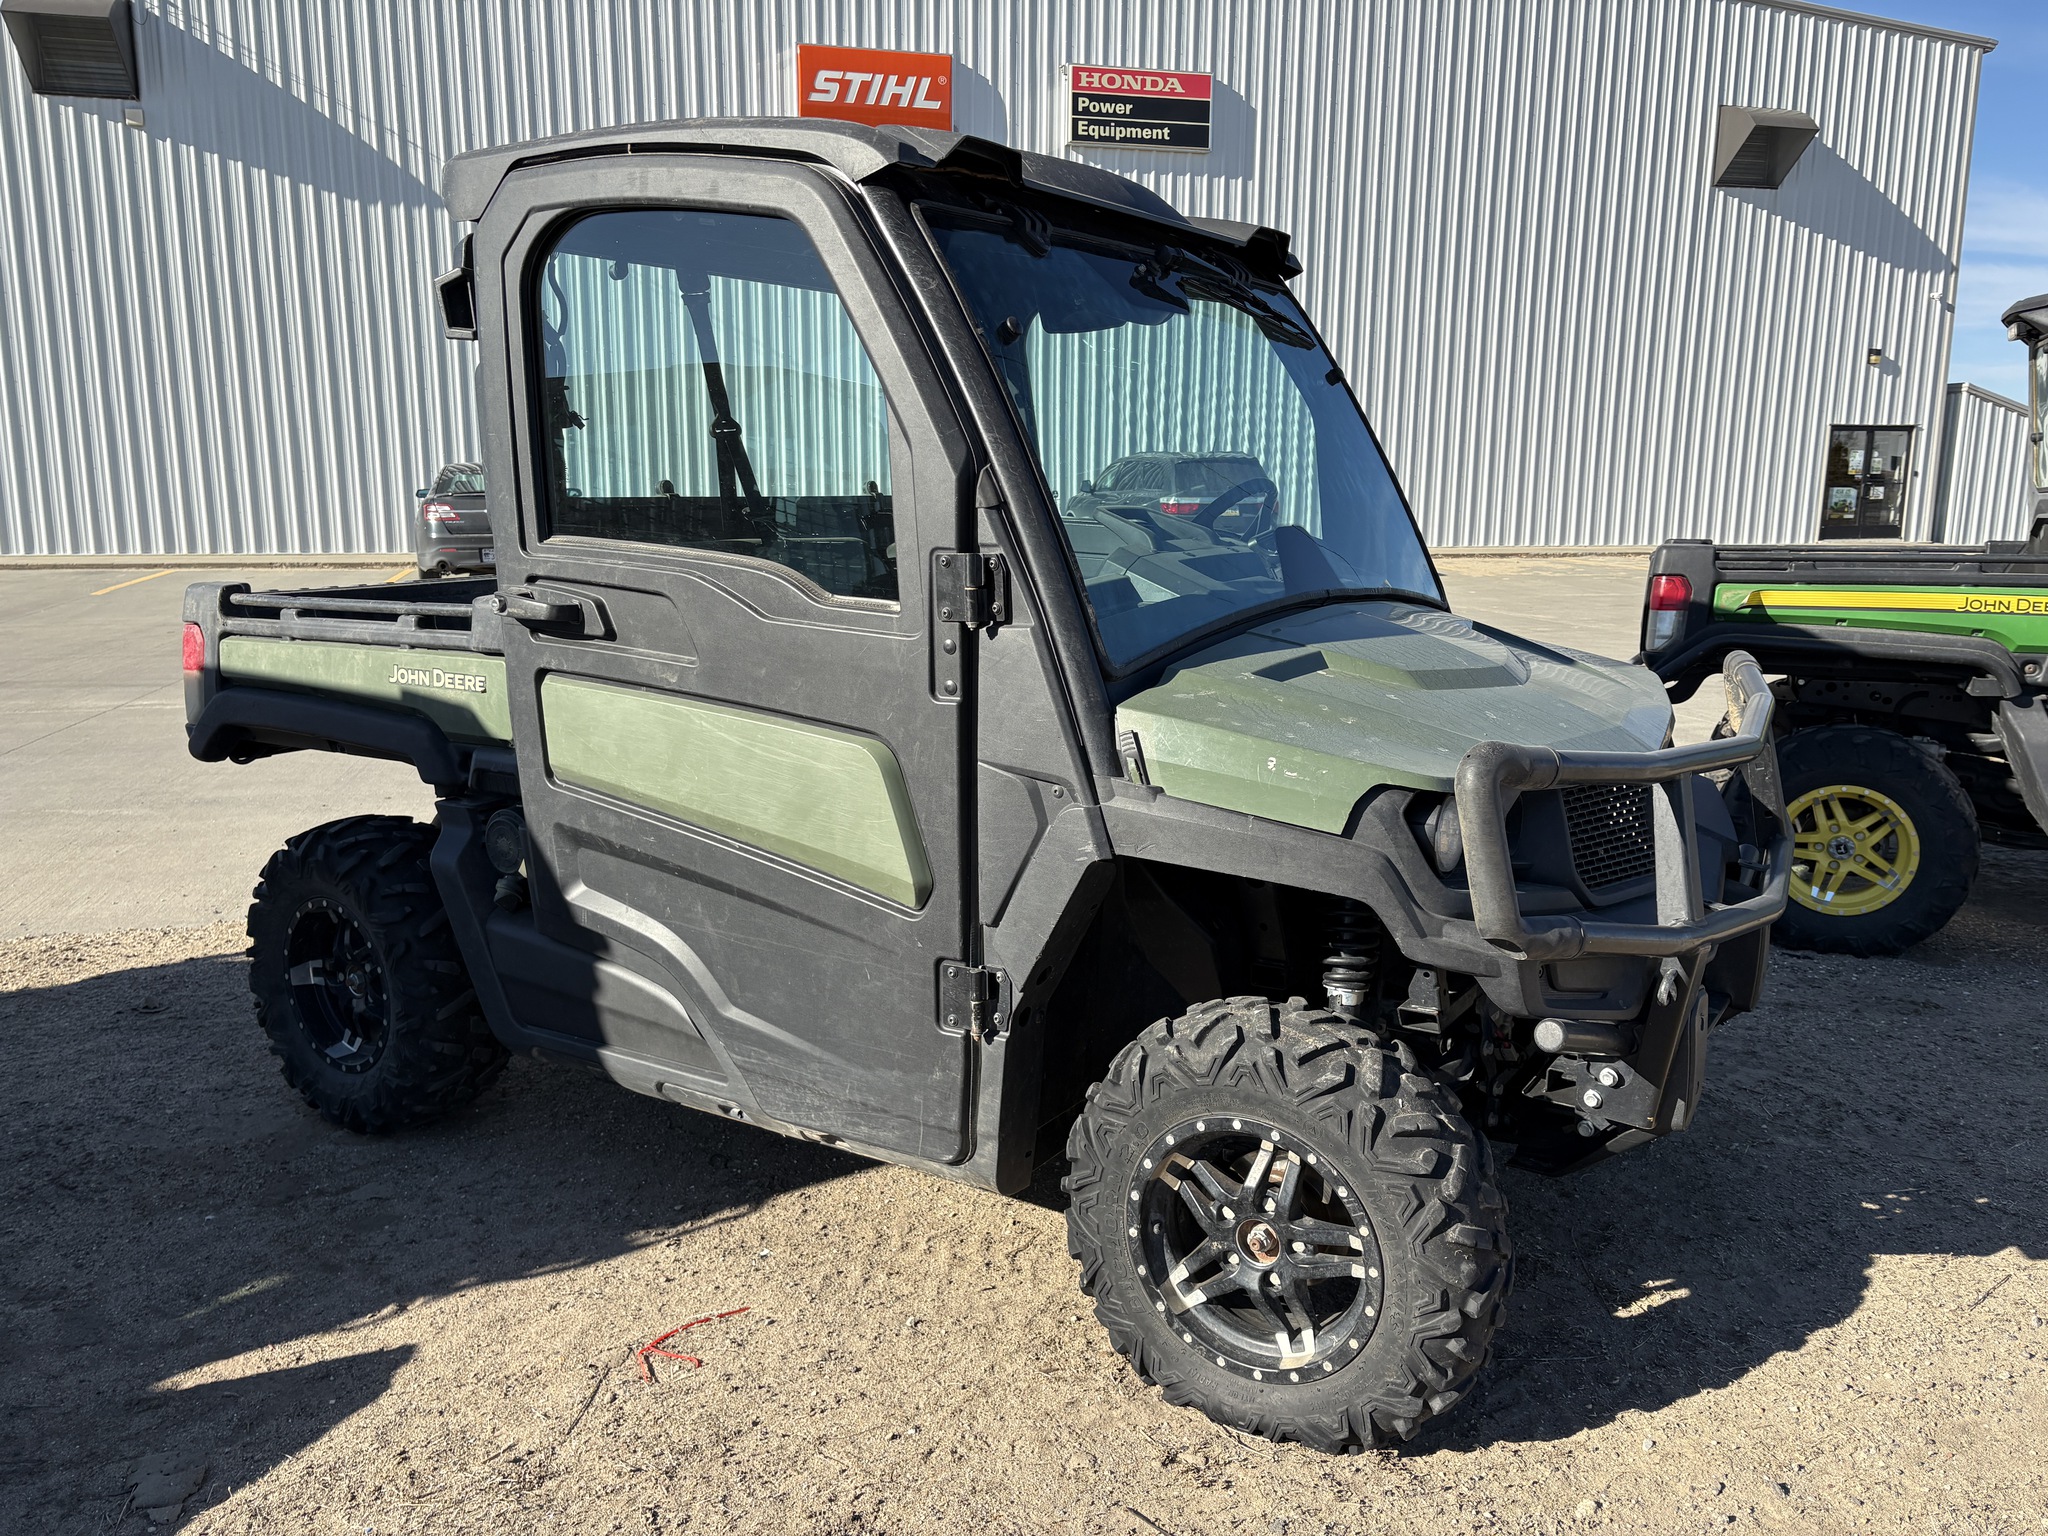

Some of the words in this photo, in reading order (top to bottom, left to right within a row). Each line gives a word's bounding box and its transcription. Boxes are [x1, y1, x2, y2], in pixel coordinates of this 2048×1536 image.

[1078, 71, 1186, 94] HONDA
[1077, 97, 1134, 116] Power
[1077, 120, 1171, 141] Equipment
[1957, 597, 2011, 611] JOHN
[388, 664, 431, 687] JOHN
[432, 668, 486, 692] DEERE
